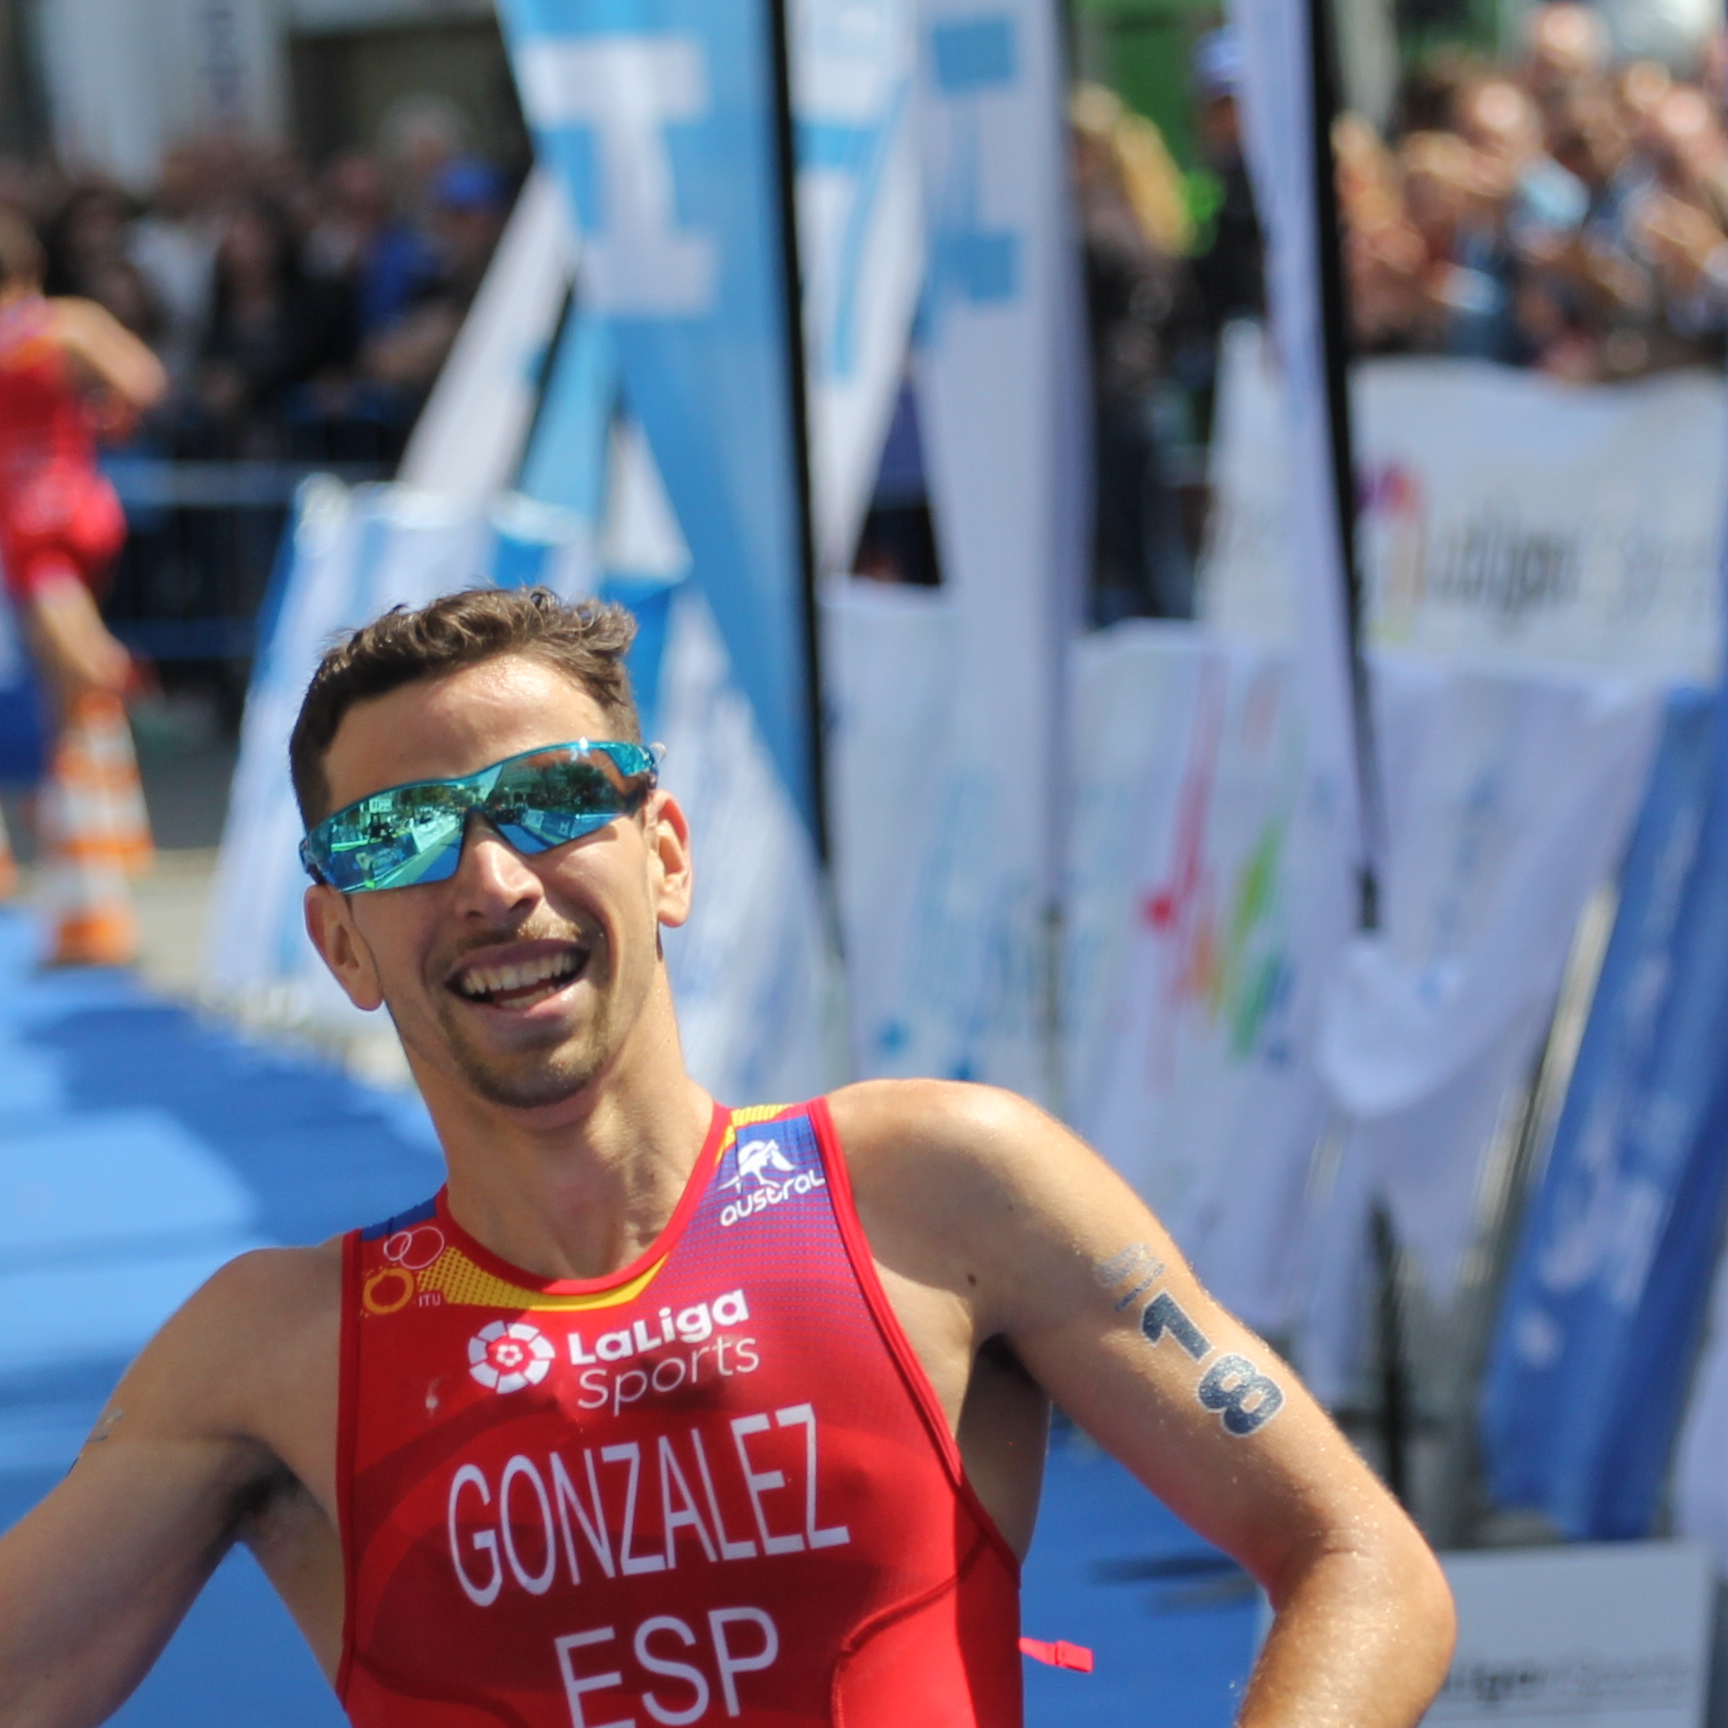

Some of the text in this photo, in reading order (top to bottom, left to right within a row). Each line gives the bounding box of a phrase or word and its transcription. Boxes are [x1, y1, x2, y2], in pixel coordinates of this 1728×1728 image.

[418, 1293, 441, 1308] ITU
[567, 1288, 750, 1366] LaLiga
[576, 1336, 760, 1418] Sports
[1139, 1286, 1286, 1438] 18
[447, 1402, 852, 1608] GONZALEZ
